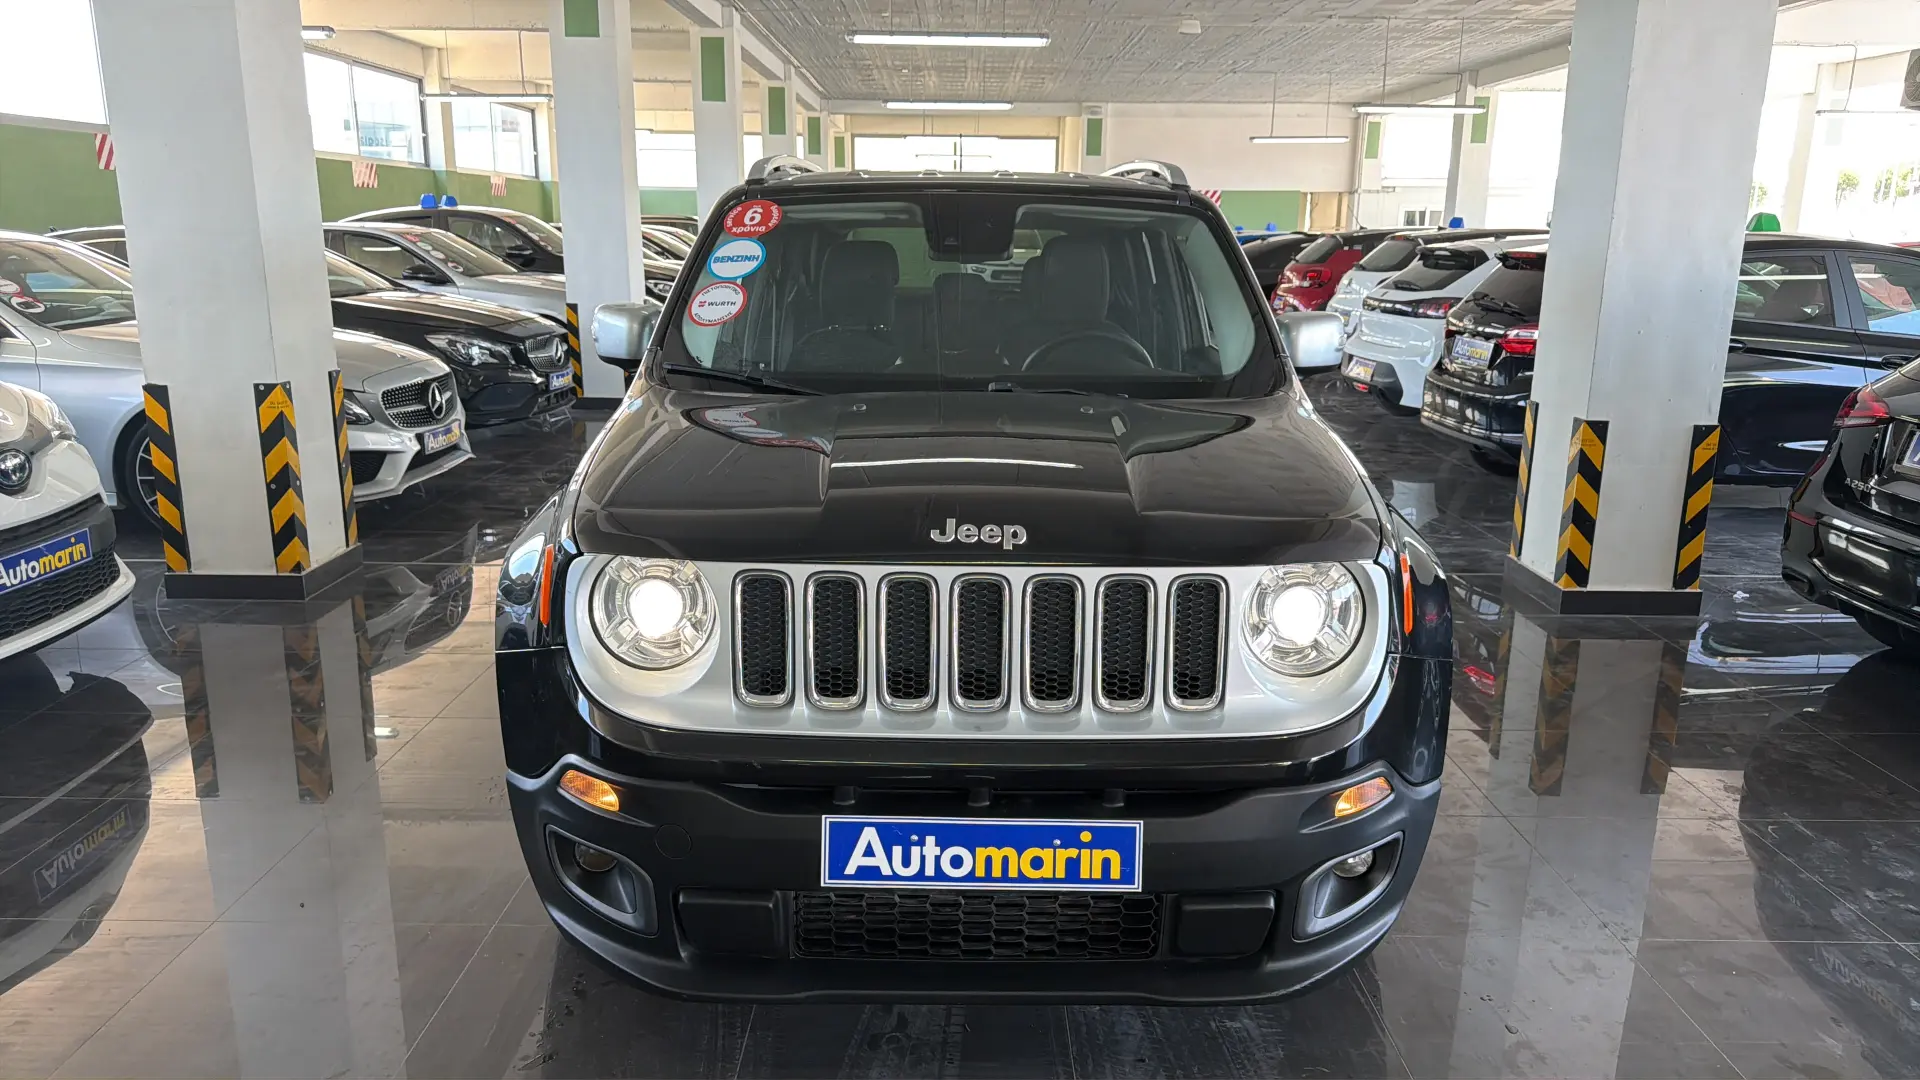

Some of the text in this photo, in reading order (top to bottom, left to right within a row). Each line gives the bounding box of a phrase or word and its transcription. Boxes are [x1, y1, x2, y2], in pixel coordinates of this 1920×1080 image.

[726, 206, 743, 228] service
[743, 208, 764, 225] 6
[731, 225, 766, 233] χρόνια
[712, 254, 760, 264] ΒΕΝΖΙΝΗ
[930, 518, 1027, 550] Jeep
[843, 826, 1121, 880] Automarin
